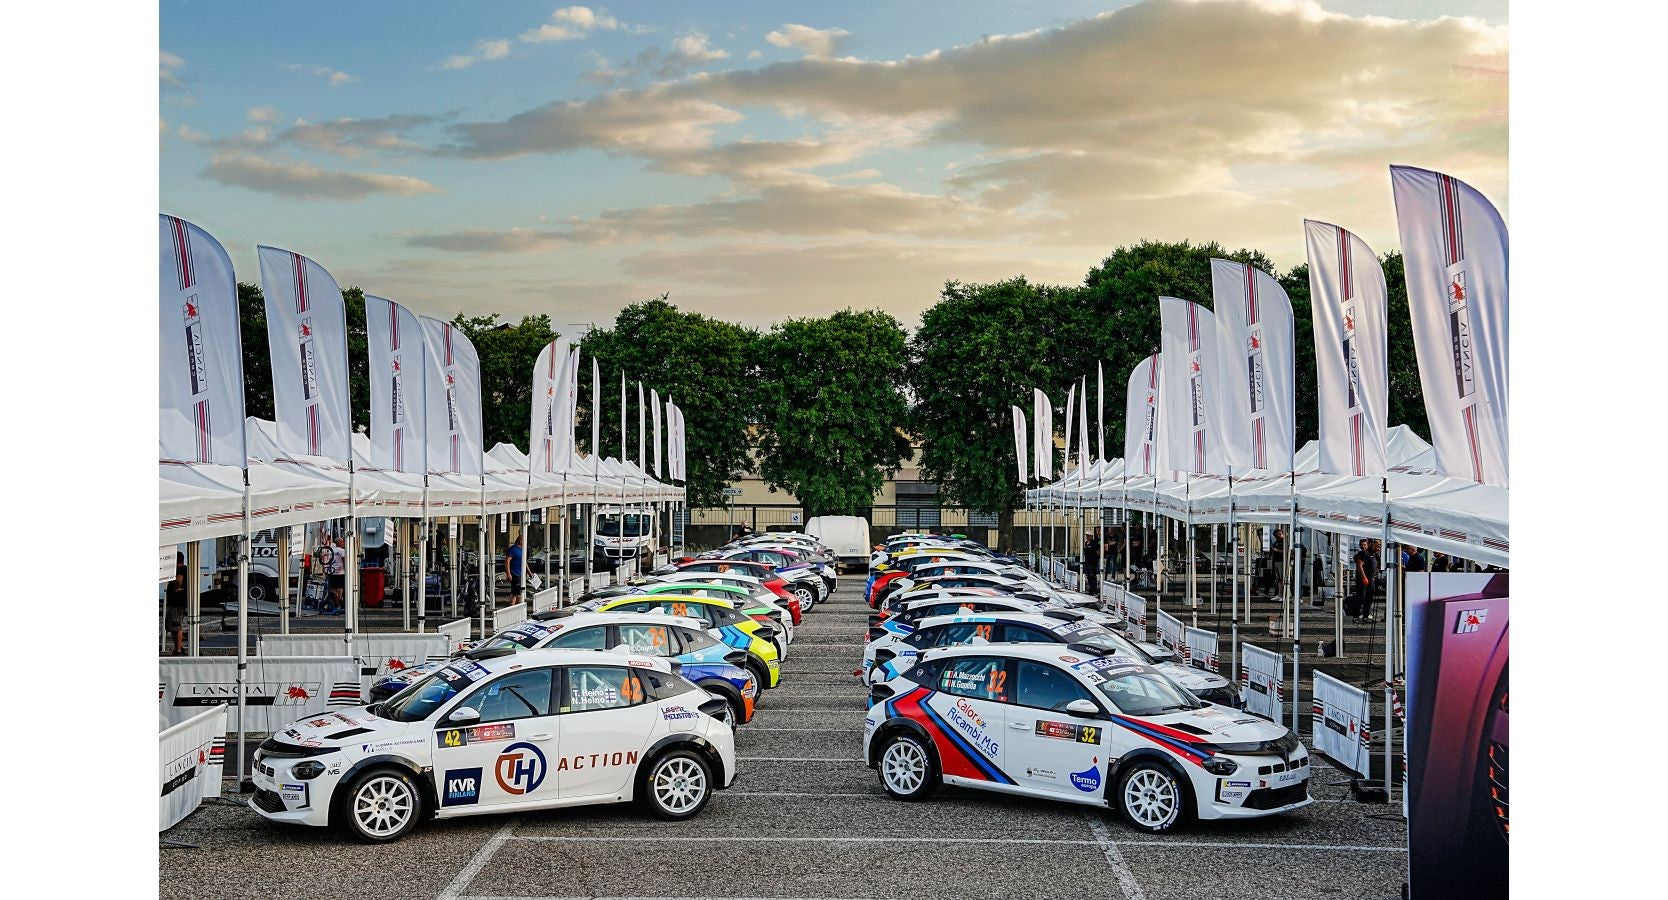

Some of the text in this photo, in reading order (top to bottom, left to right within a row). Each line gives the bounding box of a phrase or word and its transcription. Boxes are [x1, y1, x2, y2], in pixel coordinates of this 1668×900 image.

[987, 670, 1007, 693] 32
[1088, 674, 1101, 682] 32
[572, 689, 604, 697] T. Heino
[621, 677, 642, 702] 42
[957, 698, 978, 720] Calor
[947, 707, 983, 741] Ricambi
[444, 730, 461, 746] 42
[1081, 727, 1096, 743] 32
[557, 751, 639, 771] ACTION
[449, 778, 475, 792] KVR
[1072, 774, 1097, 785] Termo
